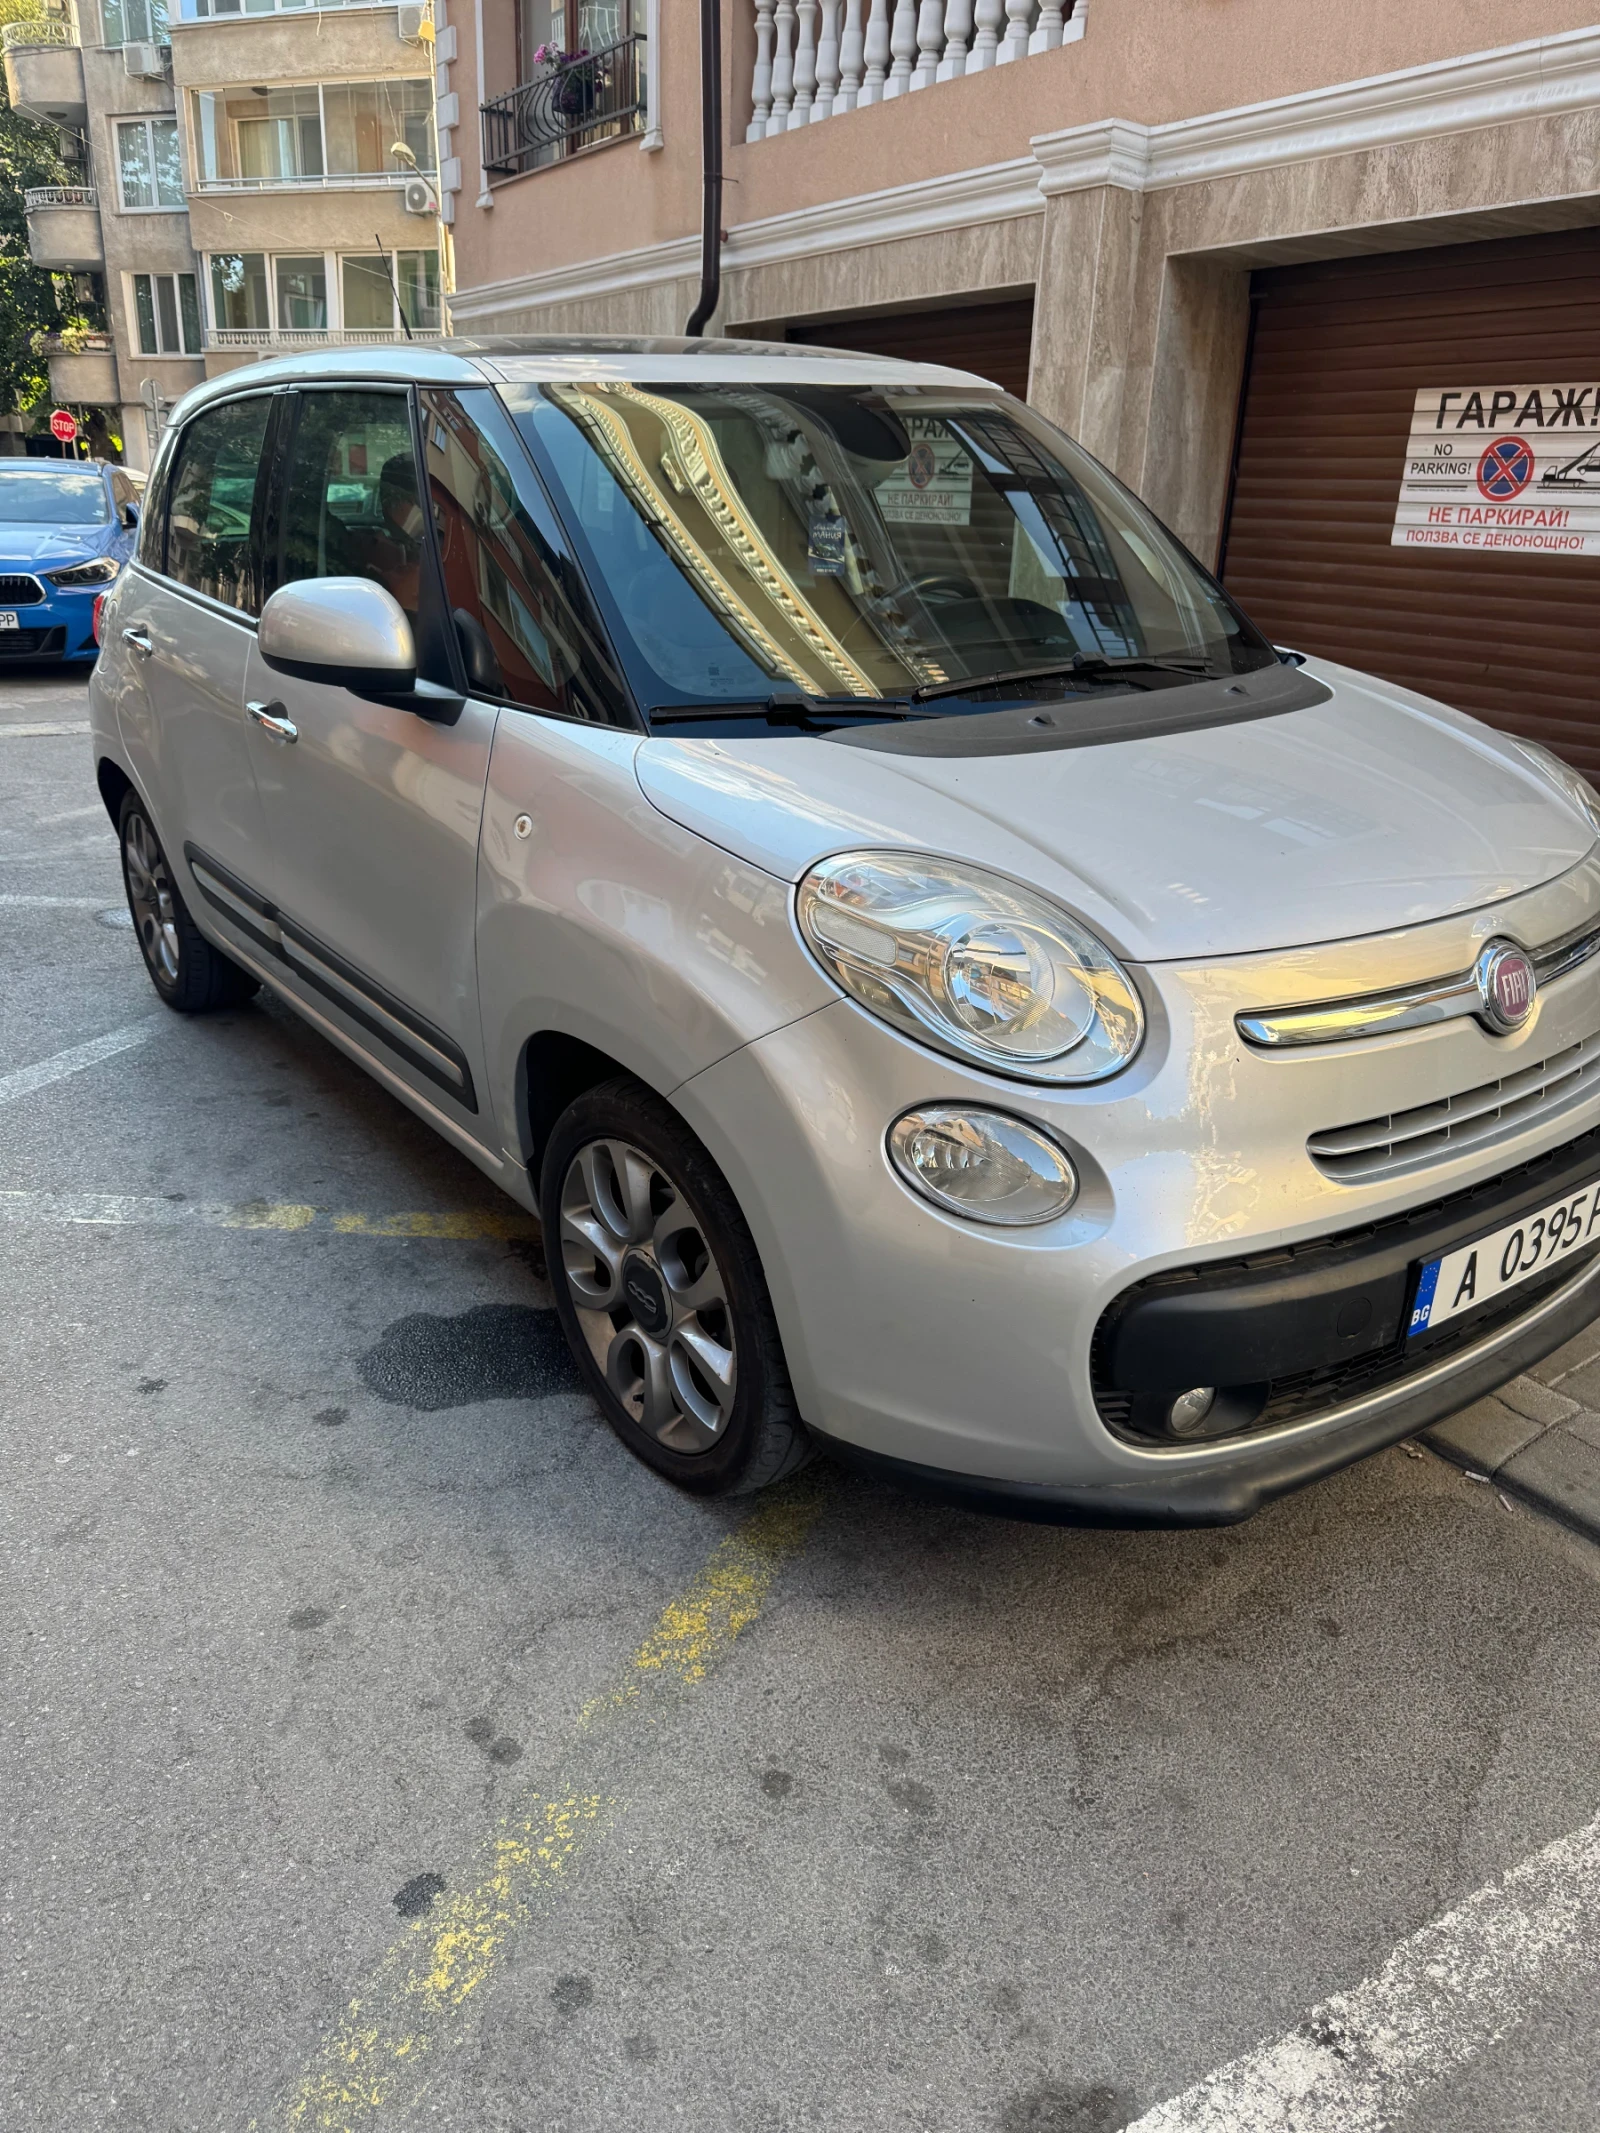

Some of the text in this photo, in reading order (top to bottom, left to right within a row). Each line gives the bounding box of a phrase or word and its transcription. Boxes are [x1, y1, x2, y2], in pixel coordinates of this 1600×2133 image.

[1436, 387, 1600, 429] ГАРАЖ!
[53, 419, 75, 433] STOP
[1434, 443, 1453, 456] NO
[1410, 462, 1471, 475] PARKING!
[888, 493, 899, 505] НЕ
[1428, 506, 1570, 528] НЕ ПАРКИРАЙ!
[1406, 529, 1584, 550] ПОЛЗВА СЕ ДЕНОНОЩНО!
[1502, 969, 1527, 1007] FIAT
[1452, 1250, 1478, 1308] A
[1411, 1304, 1430, 1326] BG
